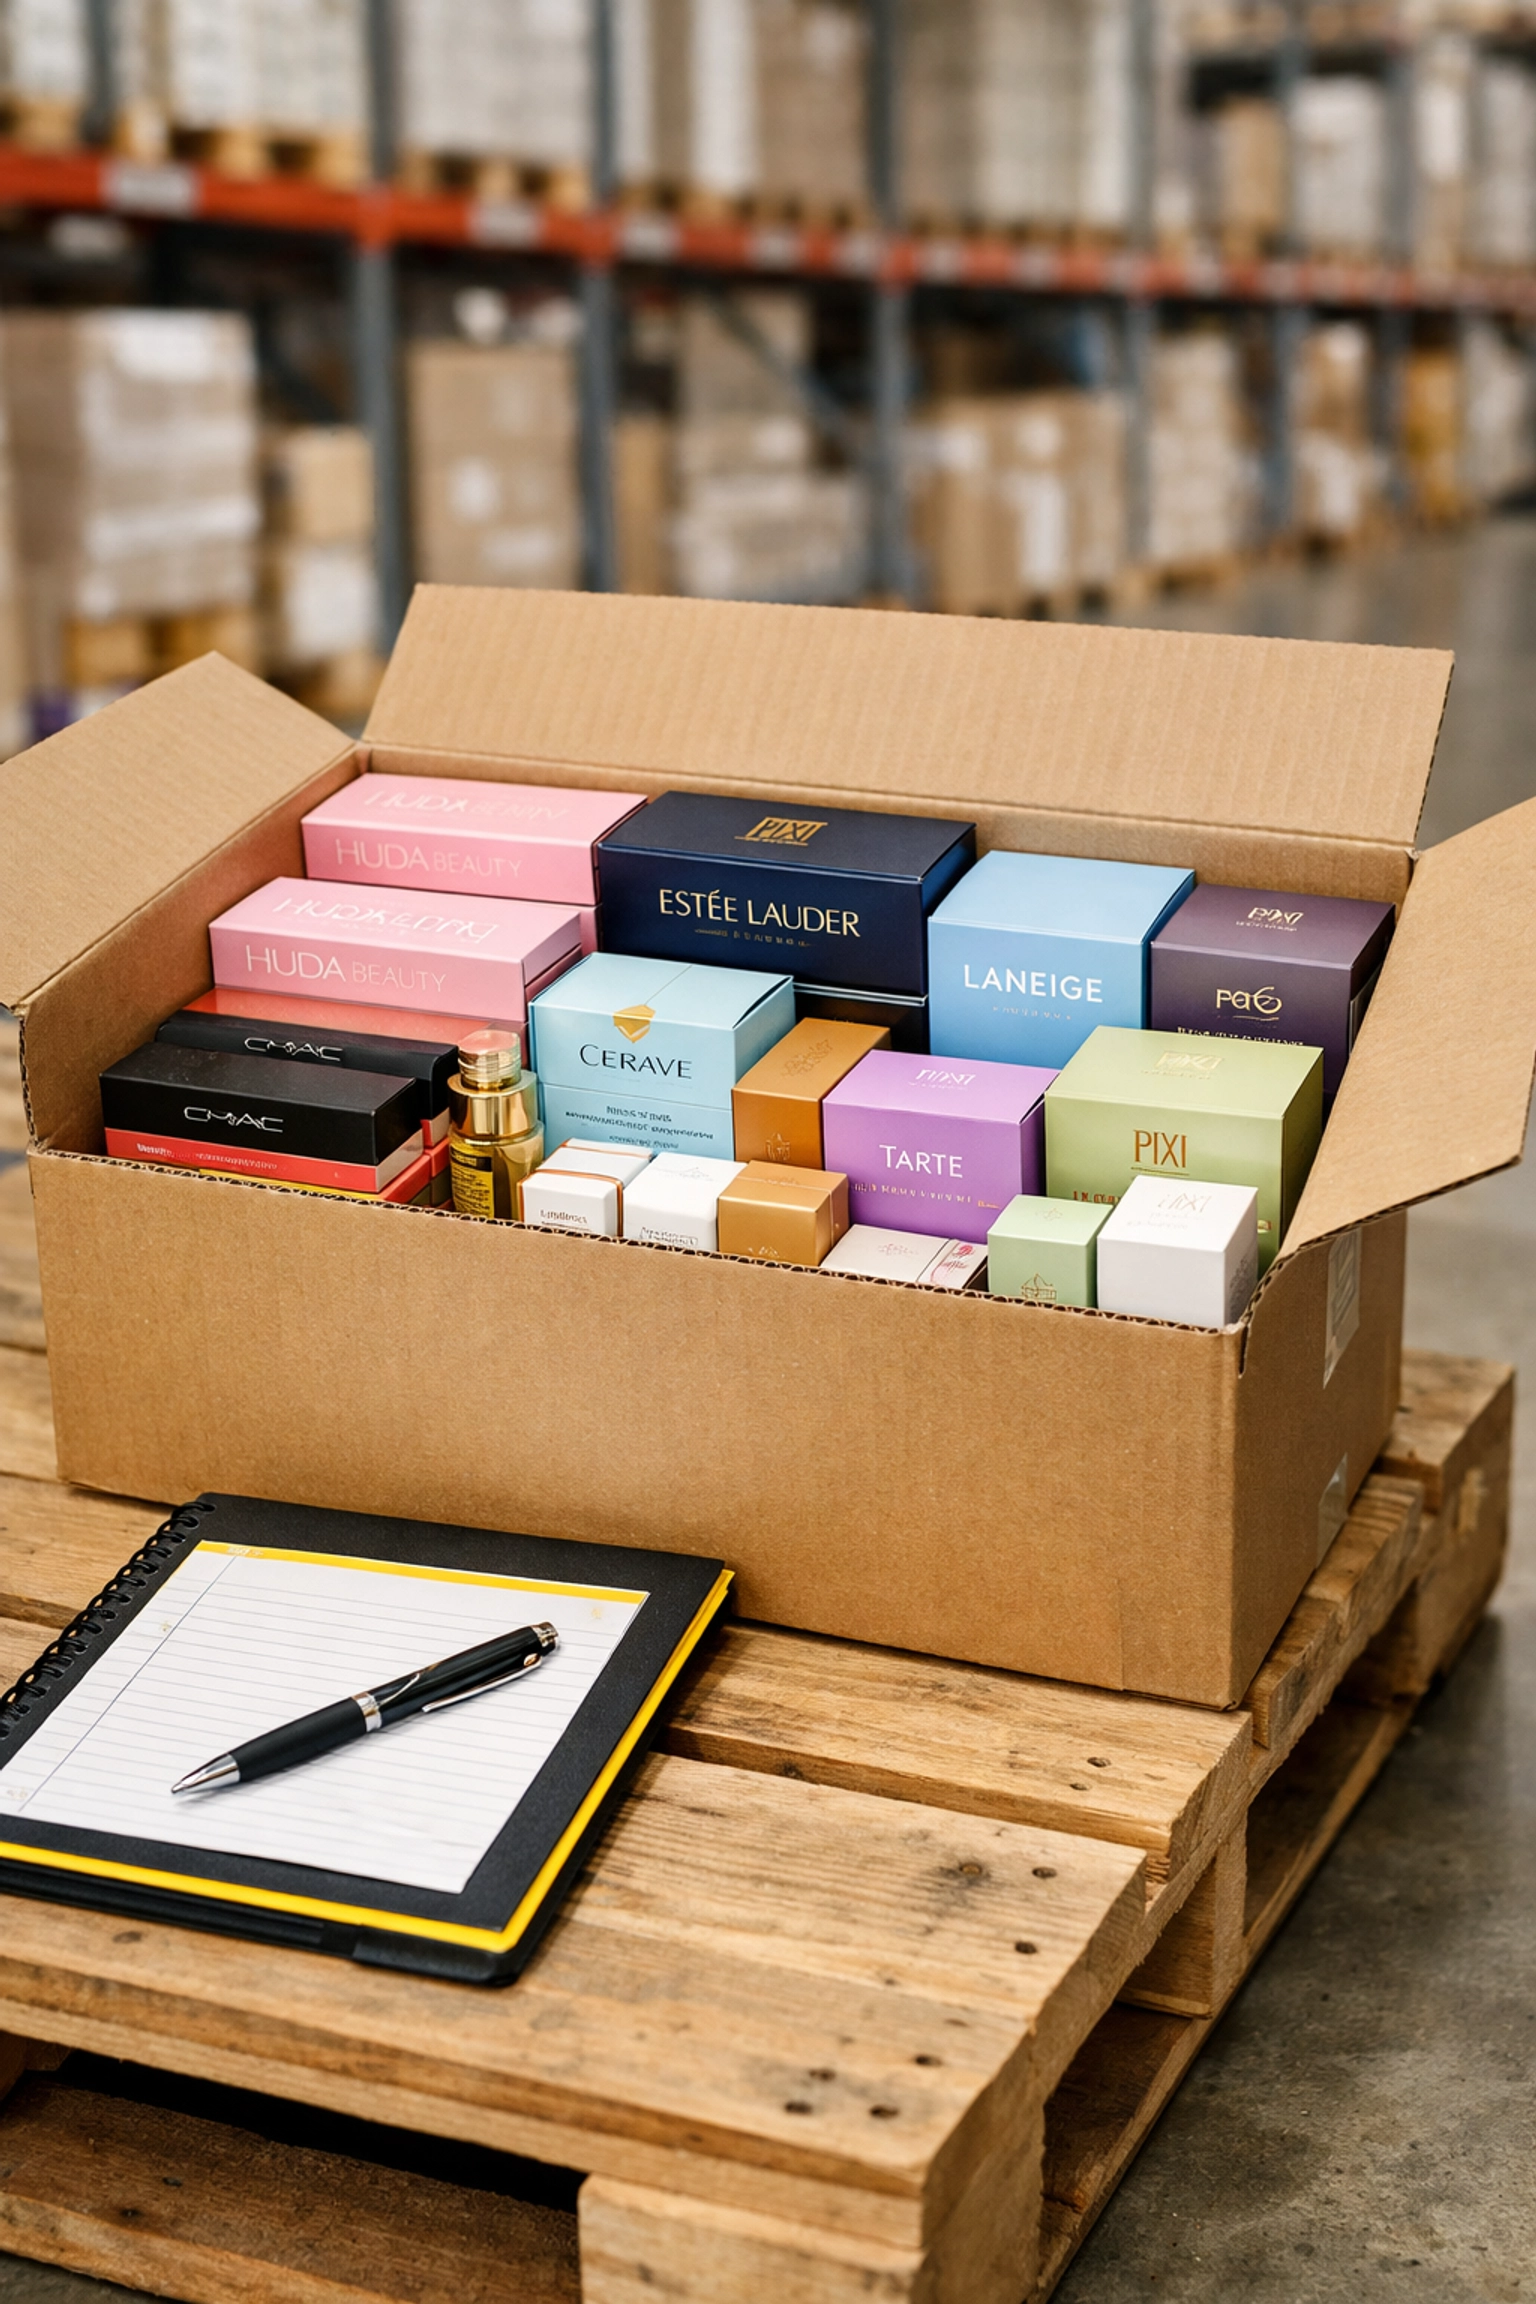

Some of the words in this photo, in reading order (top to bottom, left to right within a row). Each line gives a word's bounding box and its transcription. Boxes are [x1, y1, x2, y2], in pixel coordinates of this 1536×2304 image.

[745, 816, 829, 842] PIXI
[335, 839, 430, 871] HUDA
[433, 852, 523, 878] BEAUTY
[659, 888, 739, 922] ESTÉE
[747, 899, 861, 937] LAUDER
[245, 944, 347, 982] HUDA
[351, 961, 447, 992] BEAUTY
[964, 964, 1103, 1003] LANEIGE
[579, 1043, 693, 1079] CERAVE
[879, 1144, 964, 1178] TARTE
[1133, 1129, 1187, 1168] PIXI
